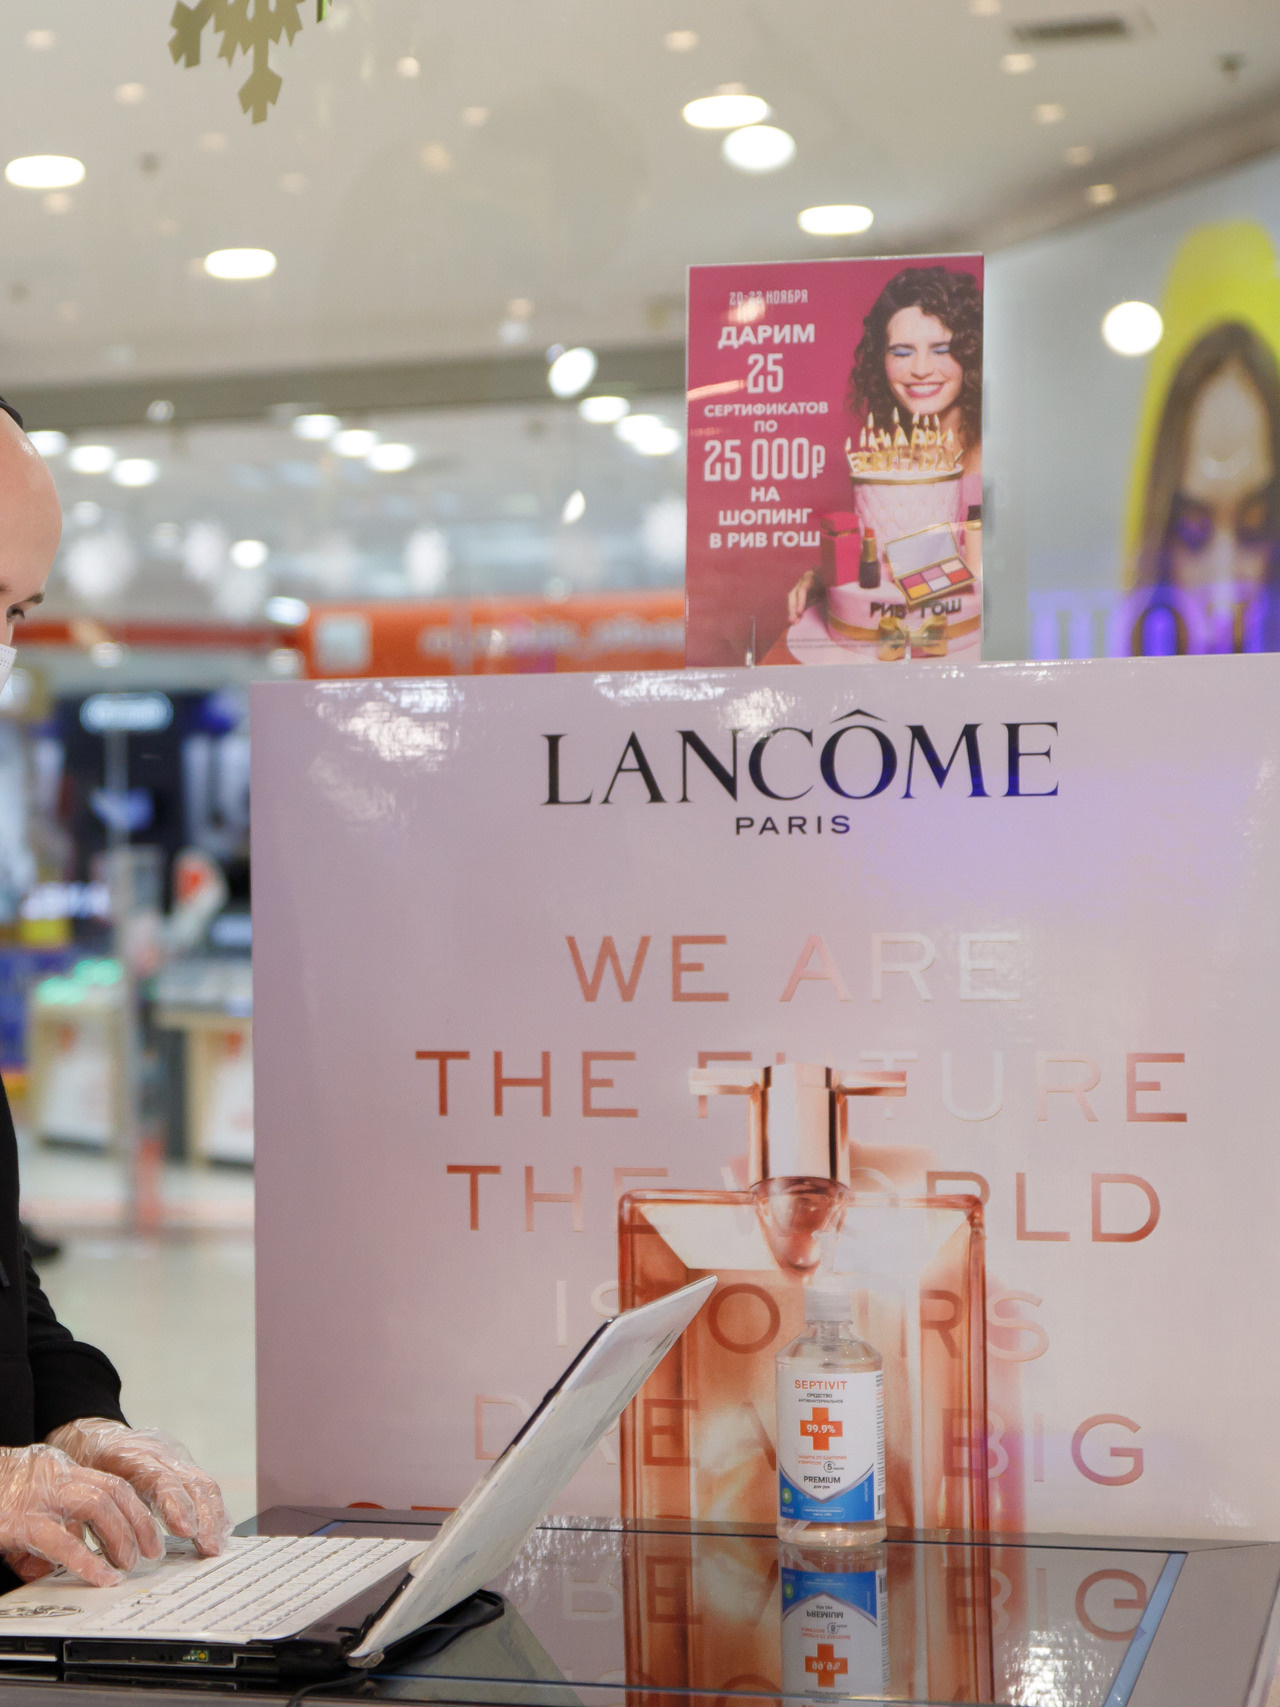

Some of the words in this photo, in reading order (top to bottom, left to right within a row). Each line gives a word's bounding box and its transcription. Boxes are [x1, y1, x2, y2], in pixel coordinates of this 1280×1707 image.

[766, 289, 808, 304] НОЯБРЯ
[718, 323, 815, 350] ДАРИМ
[747, 353, 784, 394] 25
[704, 401, 829, 418] СЕРТИФИКАТОВ
[754, 420, 778, 432] ПО
[704, 439, 742, 482] 25
[751, 486, 780, 502] НА
[719, 508, 813, 526] ШОПИНГ
[710, 533, 722, 548] В
[728, 532, 768, 548] РИВ
[773, 531, 821, 547] ГОШ
[870, 602, 907, 619] РИВ
[920, 598, 962, 617] ГОШ
[541, 708, 1059, 806] LANCÔME
[735, 815, 851, 835] PARIS
[565, 935, 730, 1002] WE
[779, 932, 1021, 1002] ARE
[415, 1050, 639, 1118] THE
[697, 1051, 1189, 1123] FTURE
[447, 1164, 671, 1236] THE
[720, 1166, 1161, 1243] RLD
[707, 1283, 1049, 1363] ORS
[794, 1379, 847, 1391] SEPTIVIT
[806, 1424, 836, 1434] 99.9%
[942, 1407, 1145, 1487] BIG
[803, 1476, 841, 1484] PREMIUM
